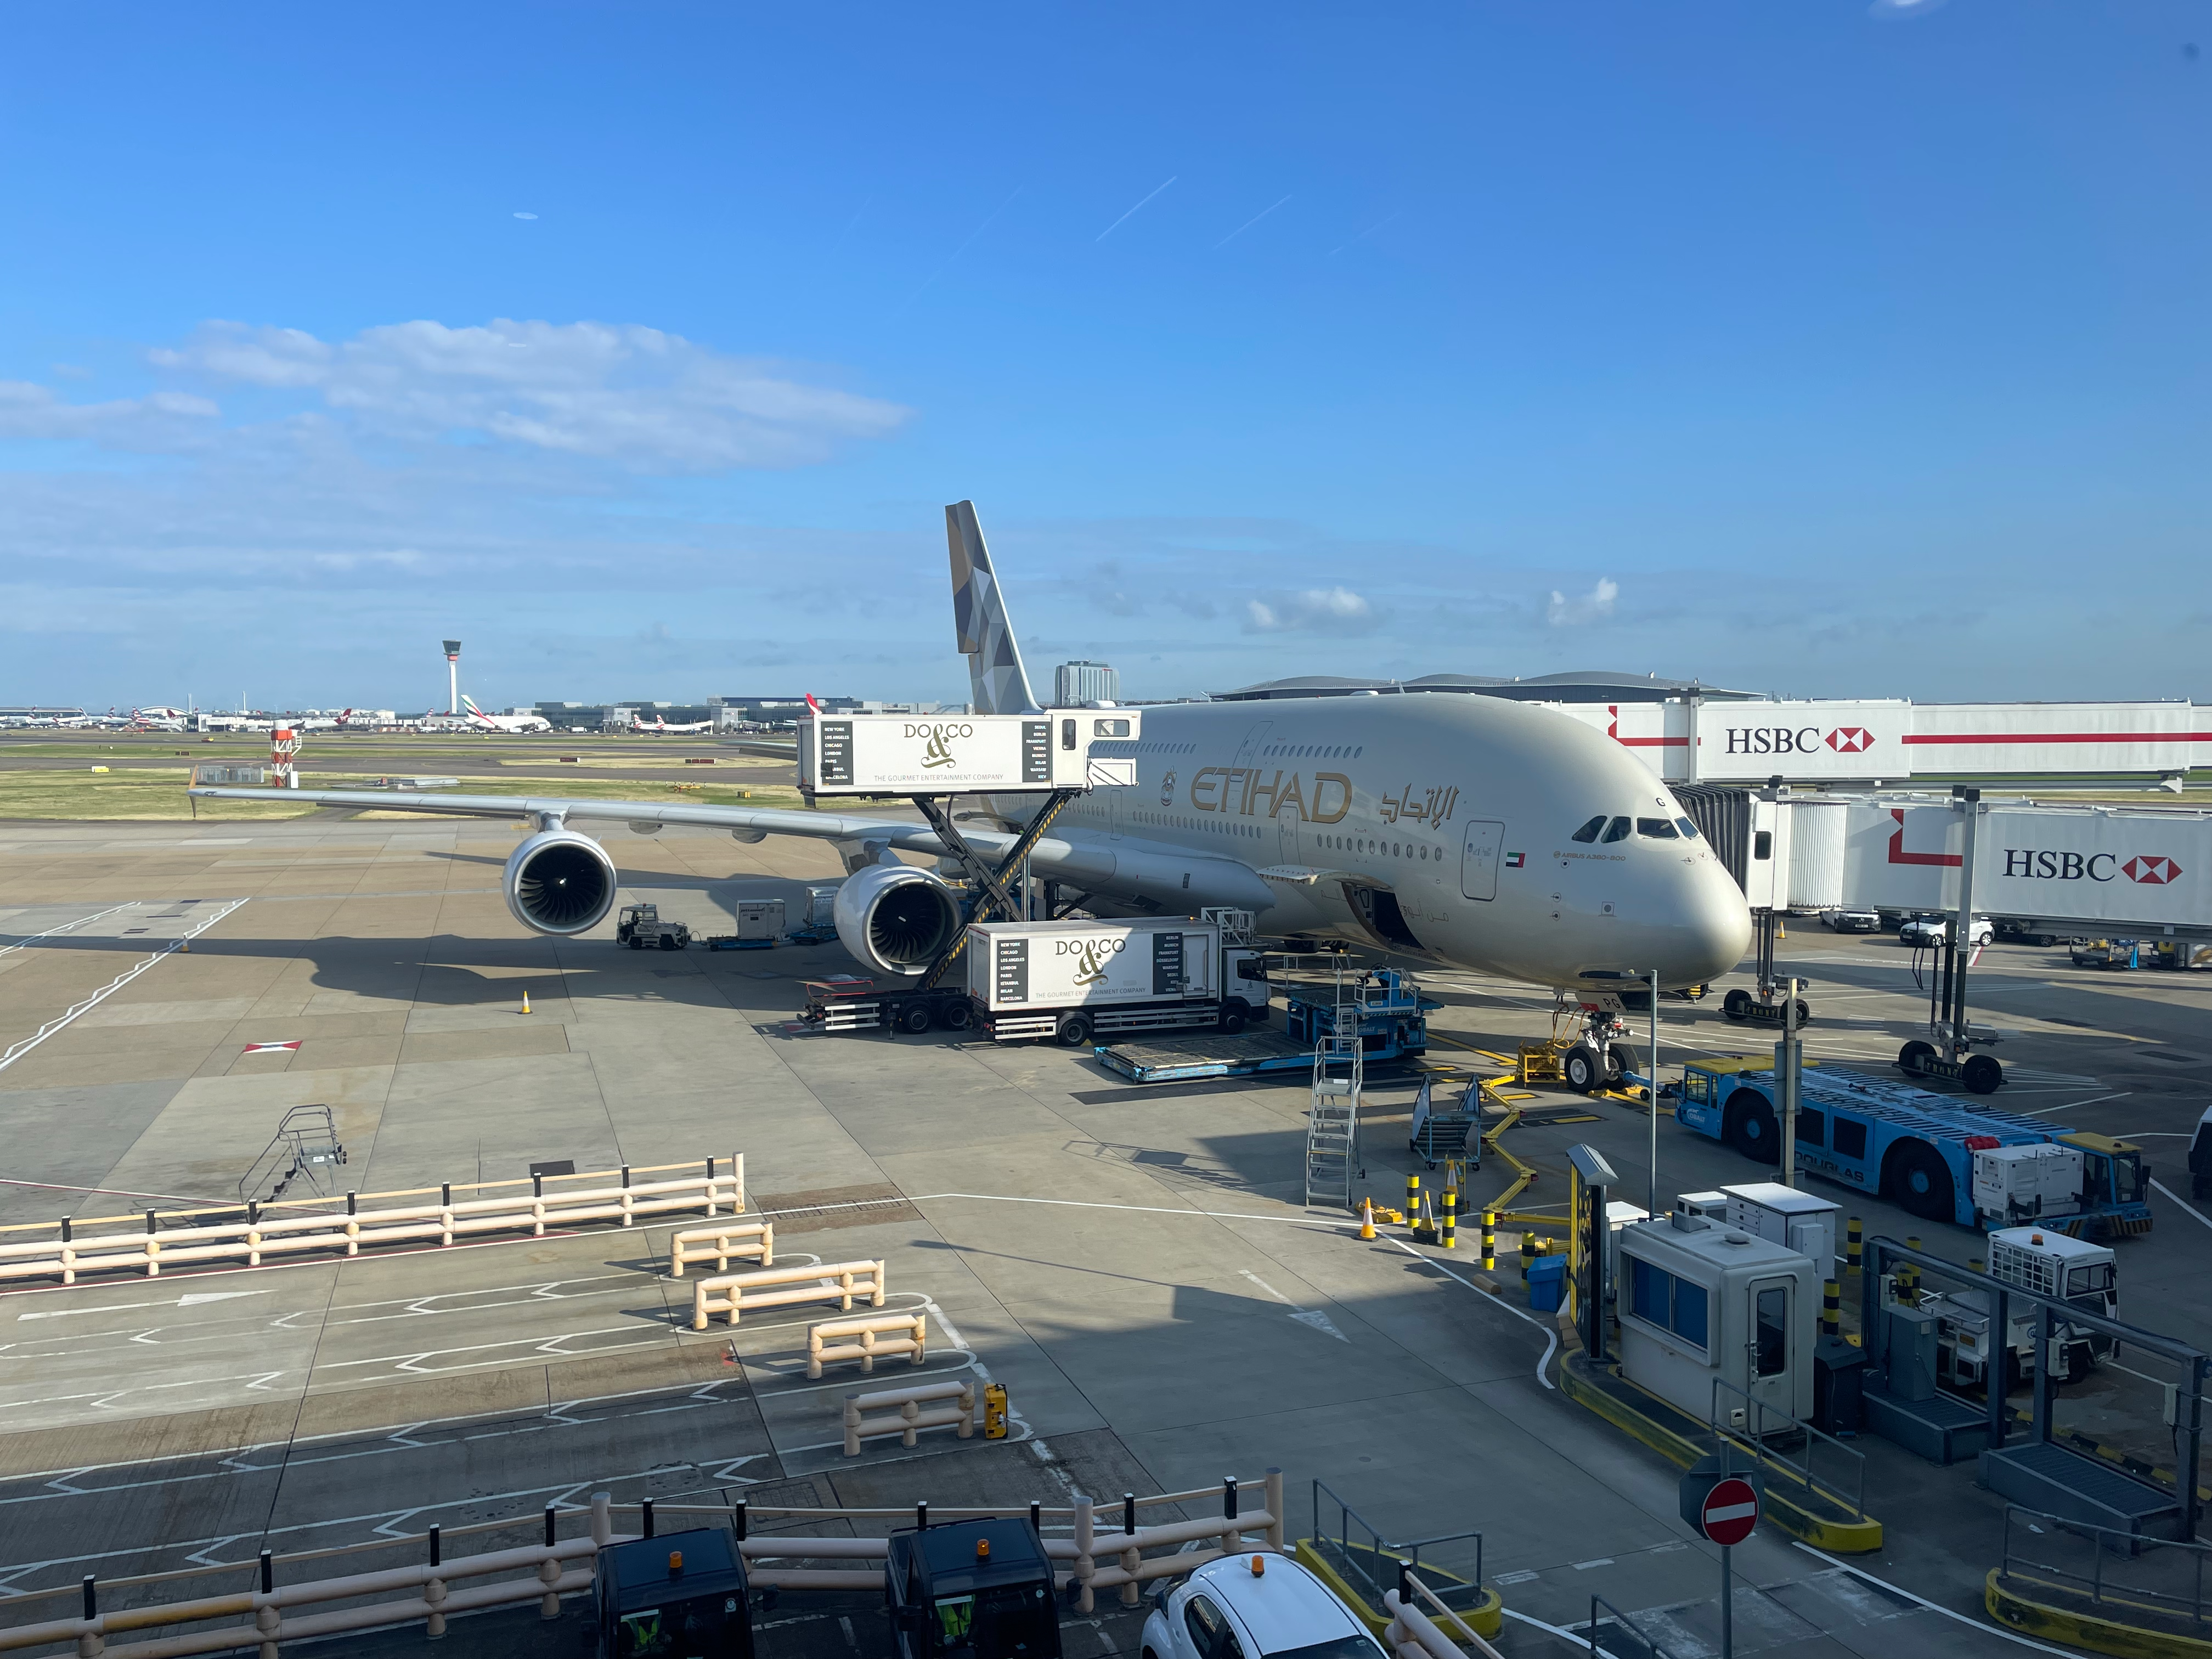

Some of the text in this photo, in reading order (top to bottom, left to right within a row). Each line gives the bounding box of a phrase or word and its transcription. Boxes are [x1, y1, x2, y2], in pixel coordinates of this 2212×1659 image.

[1725, 727, 1820, 753] HSBC
[1190, 767, 1352, 823] ETIHAD
[1656, 798, 1666, 806] G
[2002, 849, 2115, 882] HSBC
[1602, 998, 1621, 1008] PG
